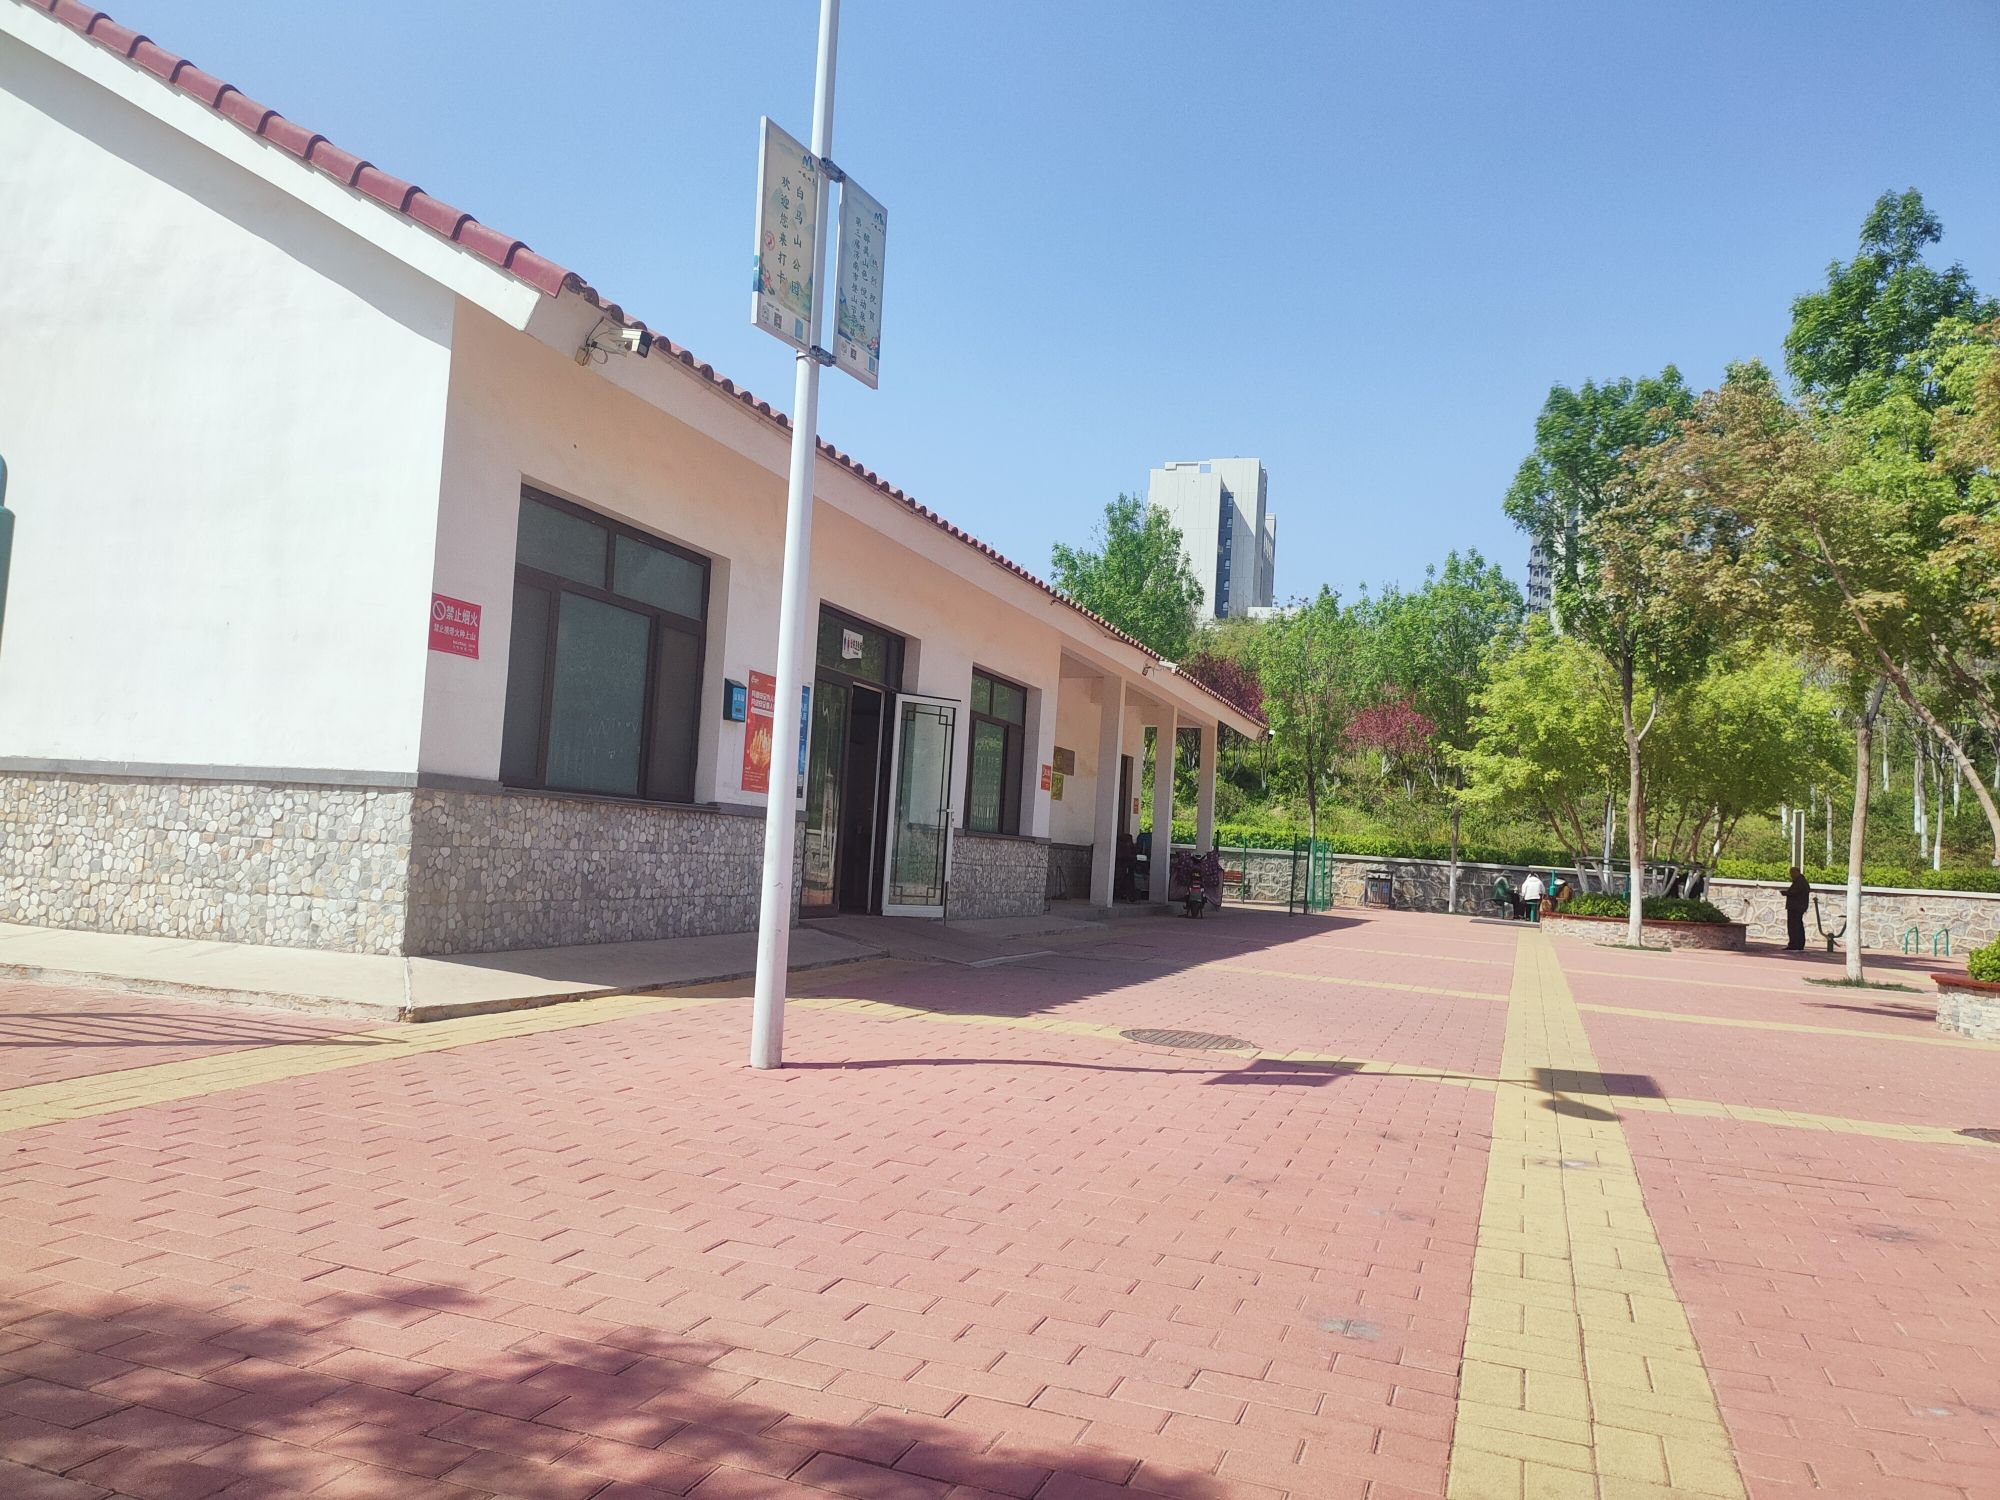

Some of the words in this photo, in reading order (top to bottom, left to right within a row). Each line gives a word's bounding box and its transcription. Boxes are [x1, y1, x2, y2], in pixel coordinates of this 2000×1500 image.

[777, 176, 791, 285] 欢迎您来打卡
[791, 186, 804, 296] 白马山公园
[446, 605, 478, 627] 禁止烟火
